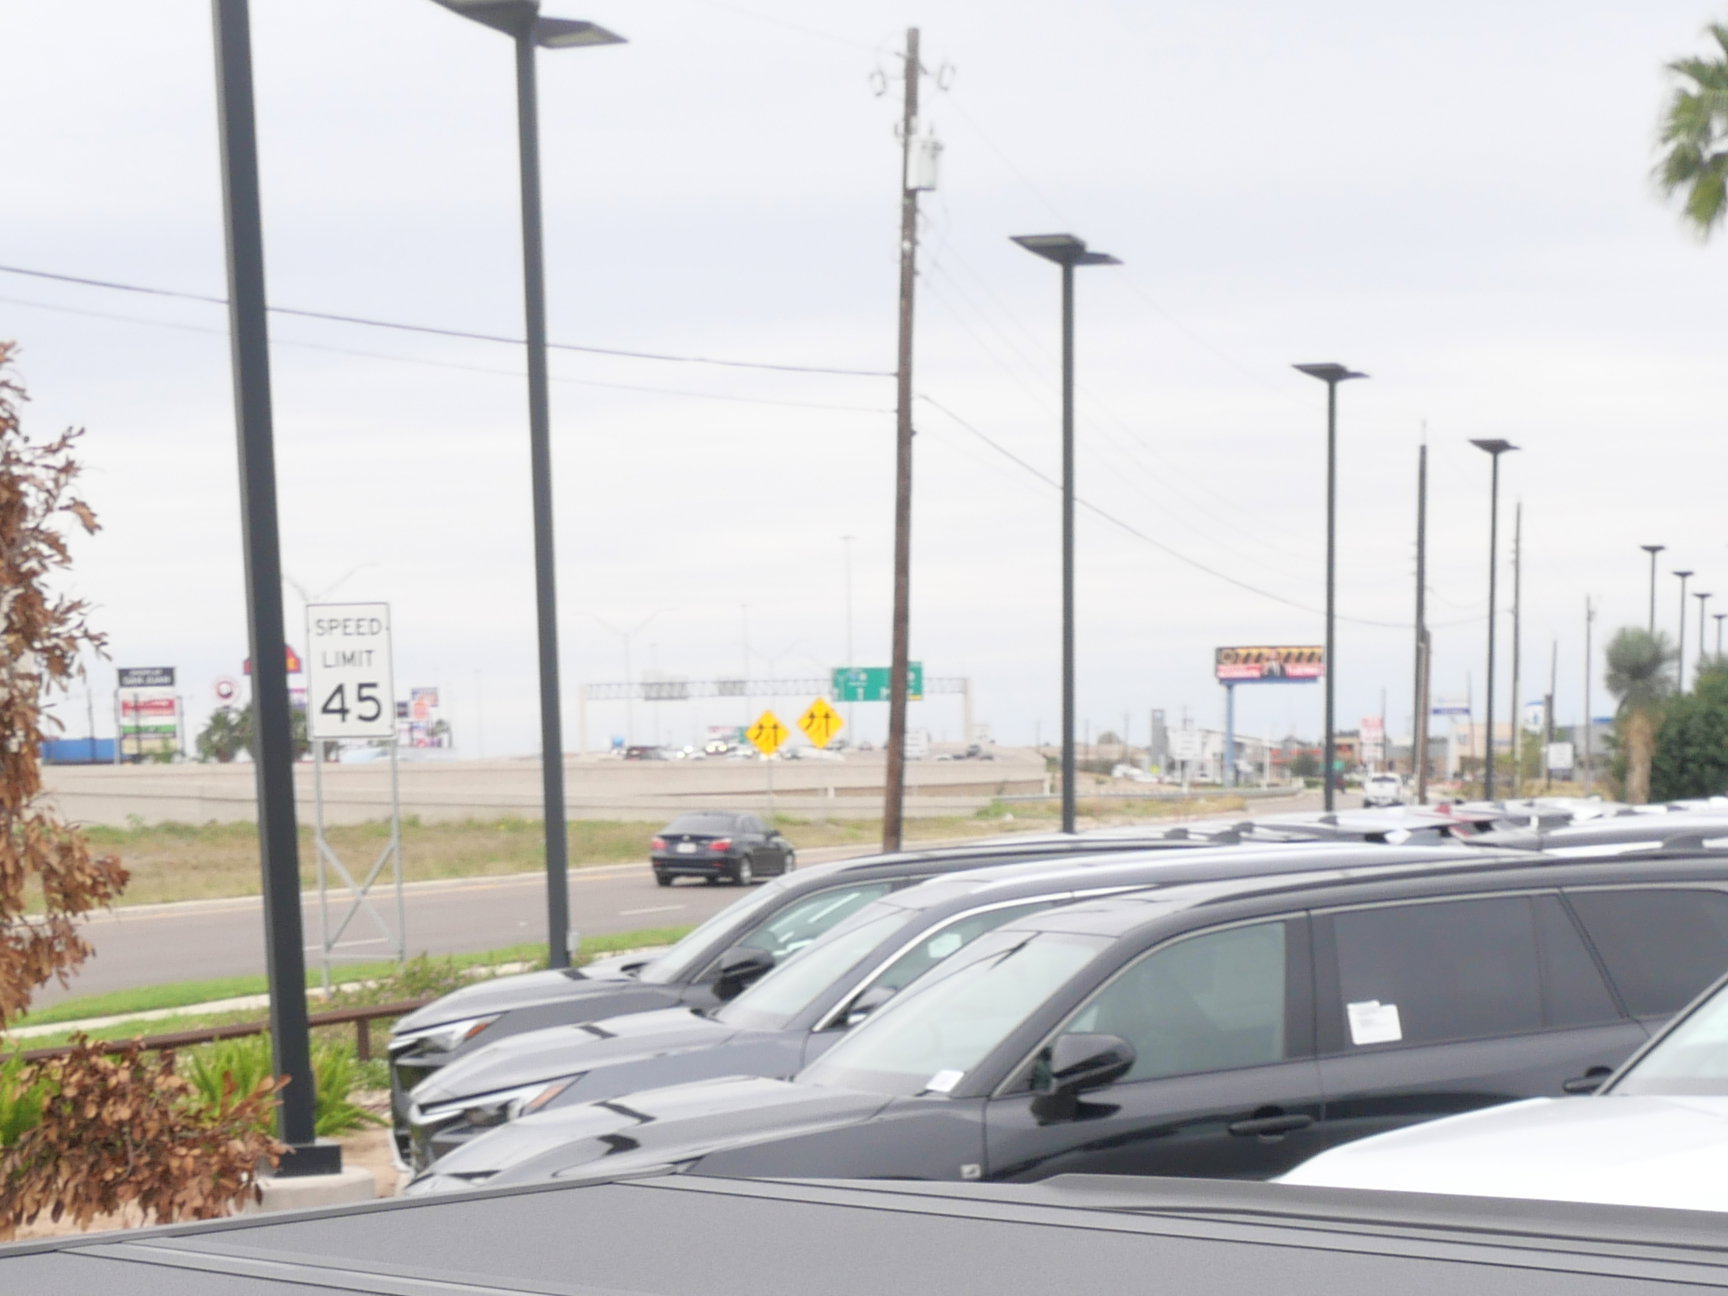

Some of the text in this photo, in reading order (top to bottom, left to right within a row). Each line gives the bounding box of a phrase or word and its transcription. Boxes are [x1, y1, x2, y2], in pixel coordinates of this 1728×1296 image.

[315, 618, 382, 636] SPEED
[321, 649, 376, 668] LIMIT
[320, 682, 382, 723] 45
